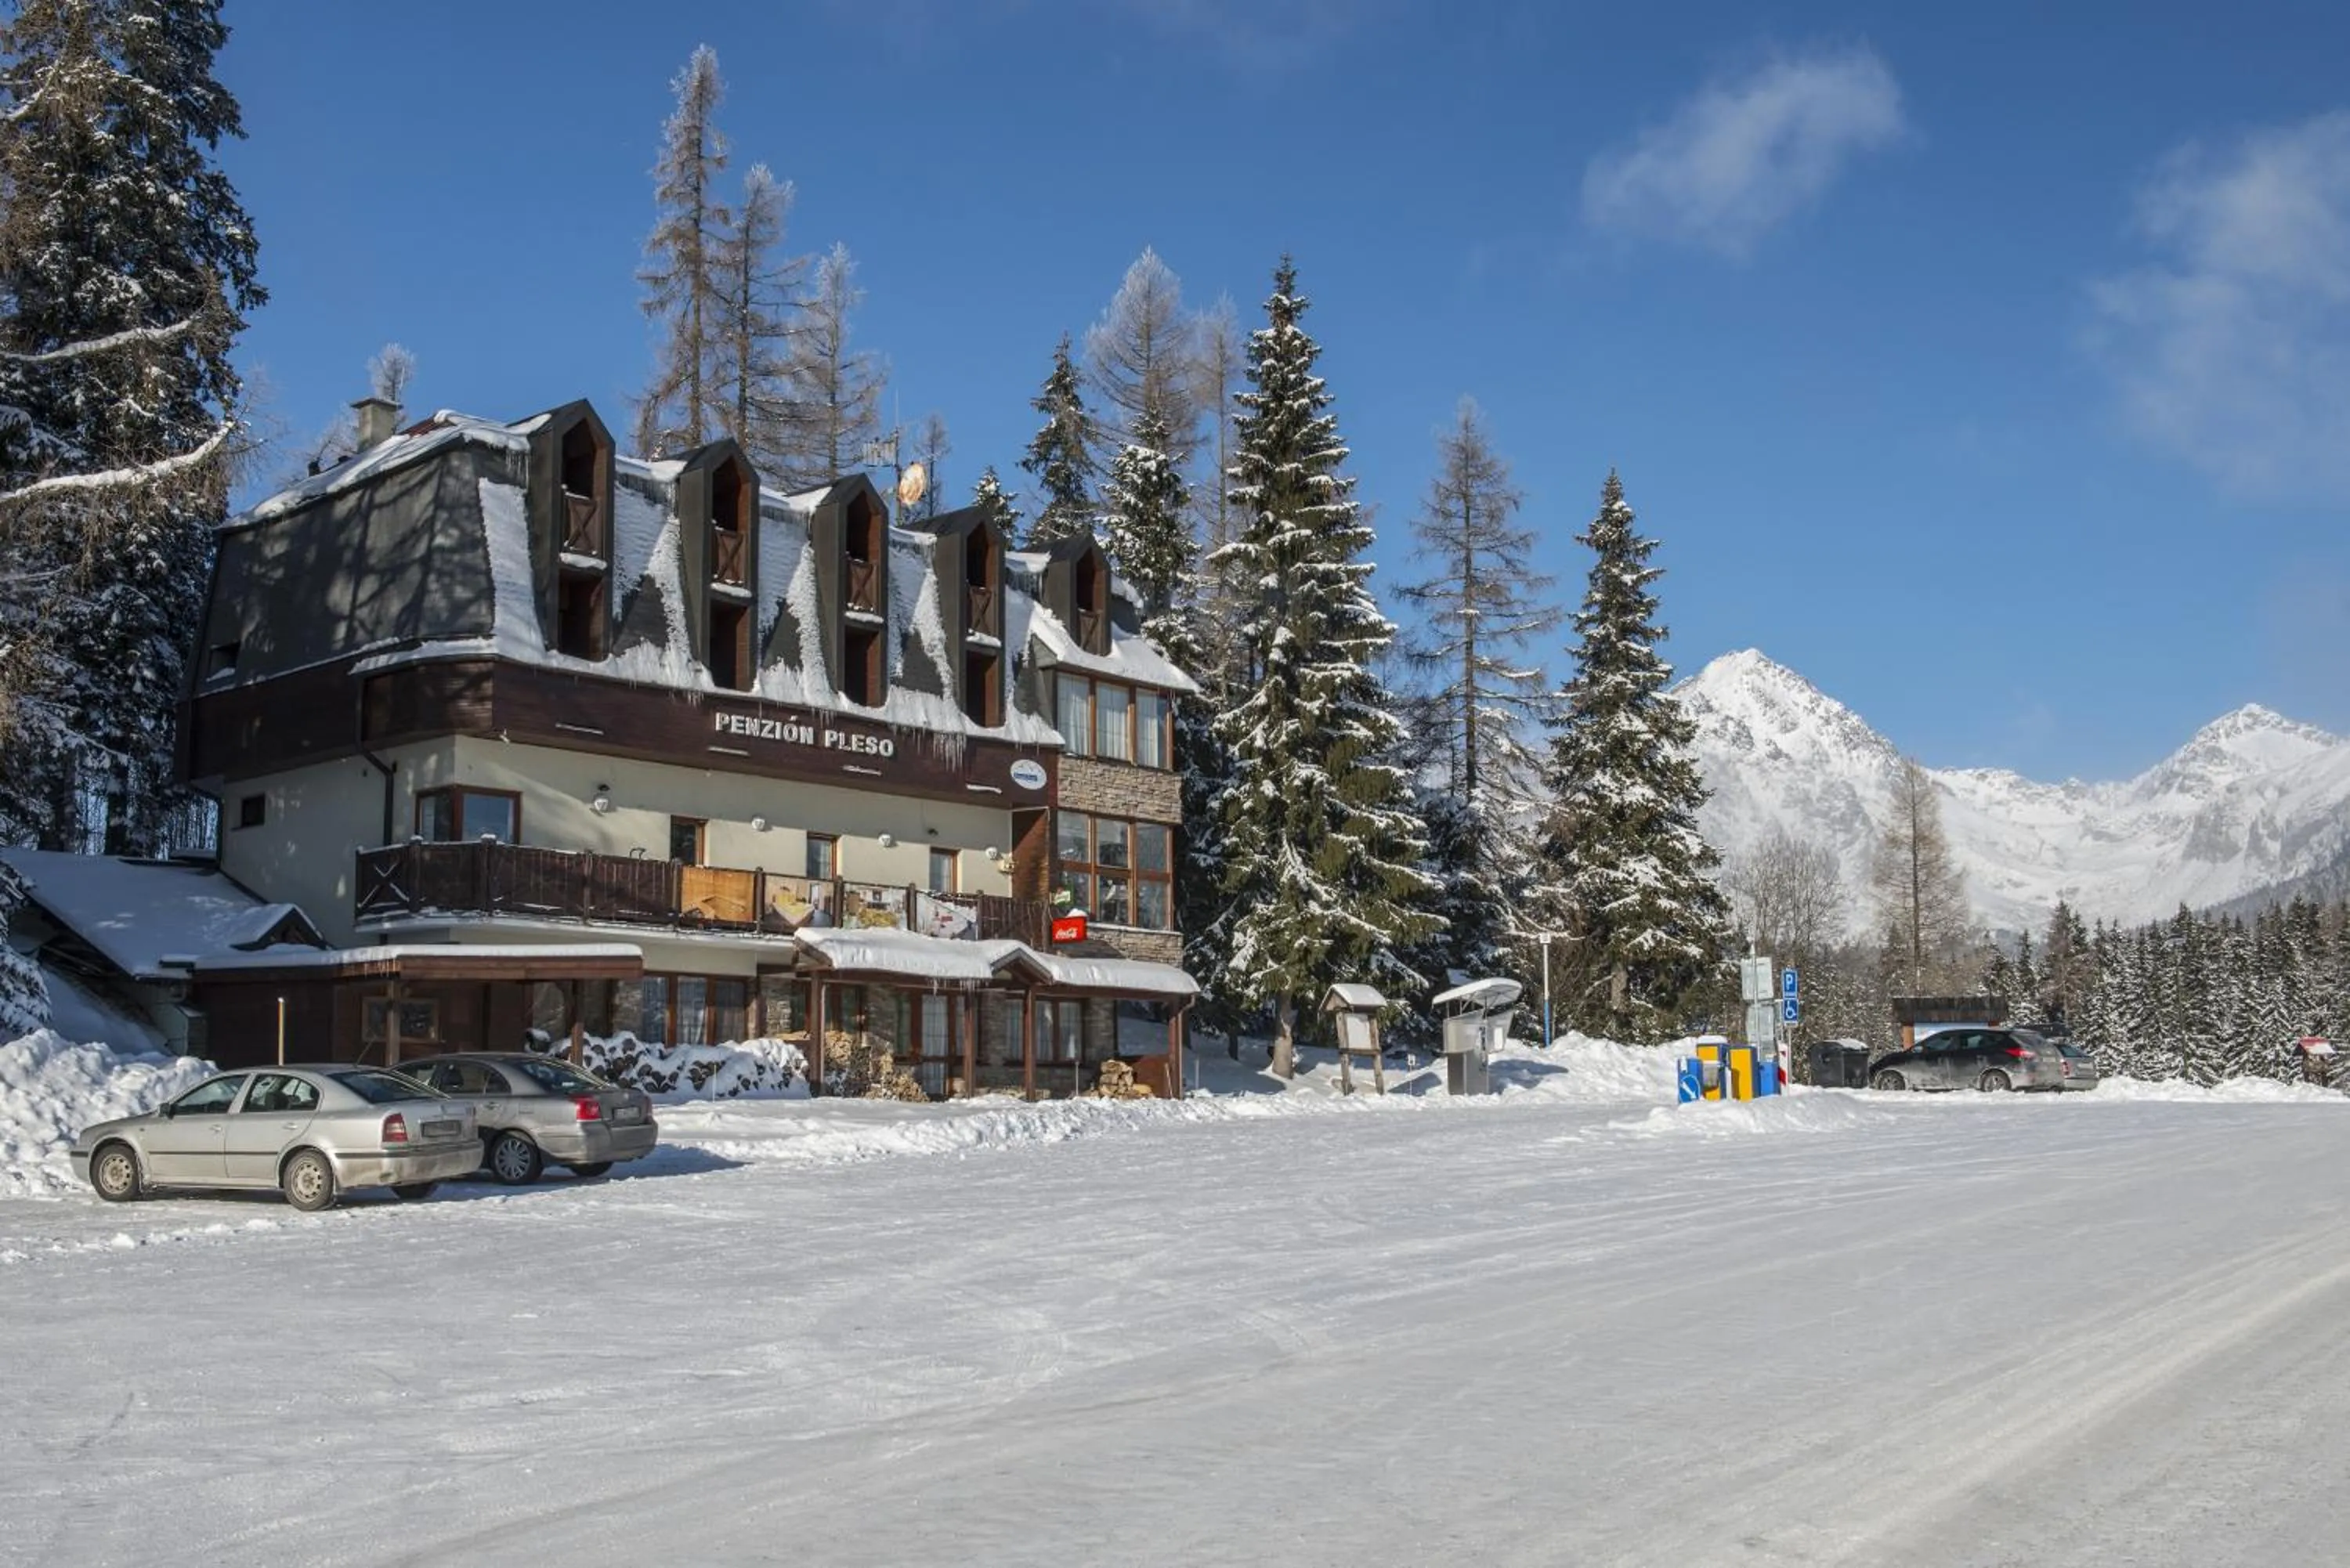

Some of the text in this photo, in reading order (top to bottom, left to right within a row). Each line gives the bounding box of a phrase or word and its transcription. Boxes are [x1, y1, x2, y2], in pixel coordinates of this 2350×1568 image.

[714, 712, 894, 757] PENZIÓN PLESO
[1786, 974, 1793, 990] P
